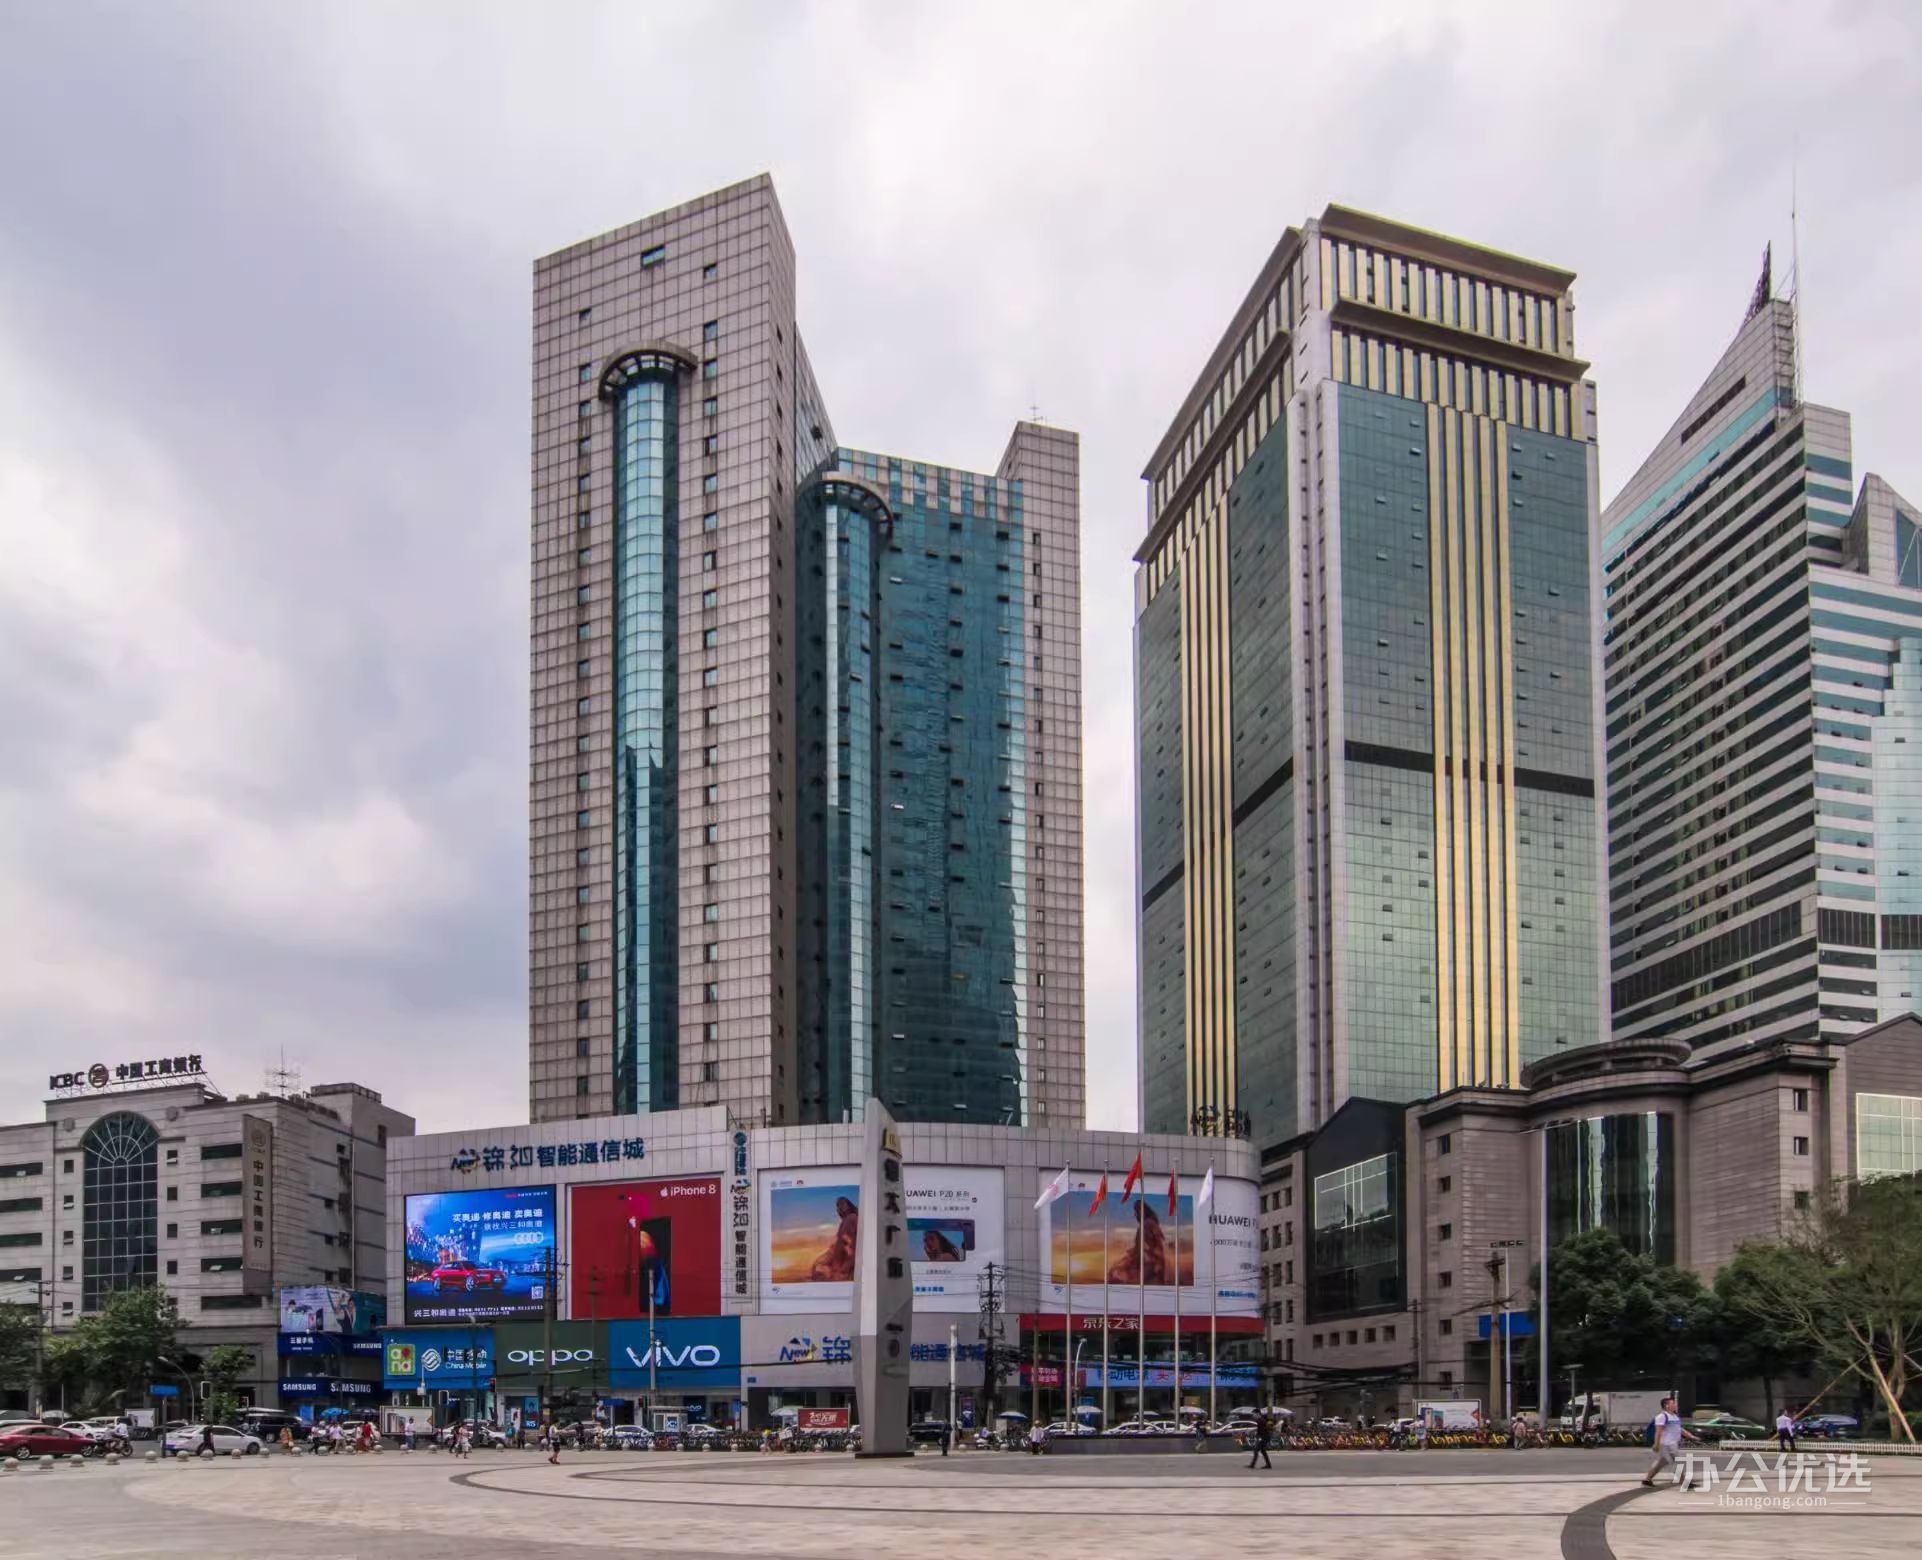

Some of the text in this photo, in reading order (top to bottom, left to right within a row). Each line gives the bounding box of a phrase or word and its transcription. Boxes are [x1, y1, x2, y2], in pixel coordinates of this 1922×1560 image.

[50, 1072, 84, 1090] ICBC
[670, 1186, 706, 1197] iPhone
[709, 1184, 716, 1195] 8
[905, 1190, 936, 1198] UAWEI
[1208, 1214, 1251, 1228] HUAWEI
[507, 1349, 593, 1366] oppo
[626, 1340, 721, 1367] vivo
[282, 1383, 317, 1391] SAMSUNG
